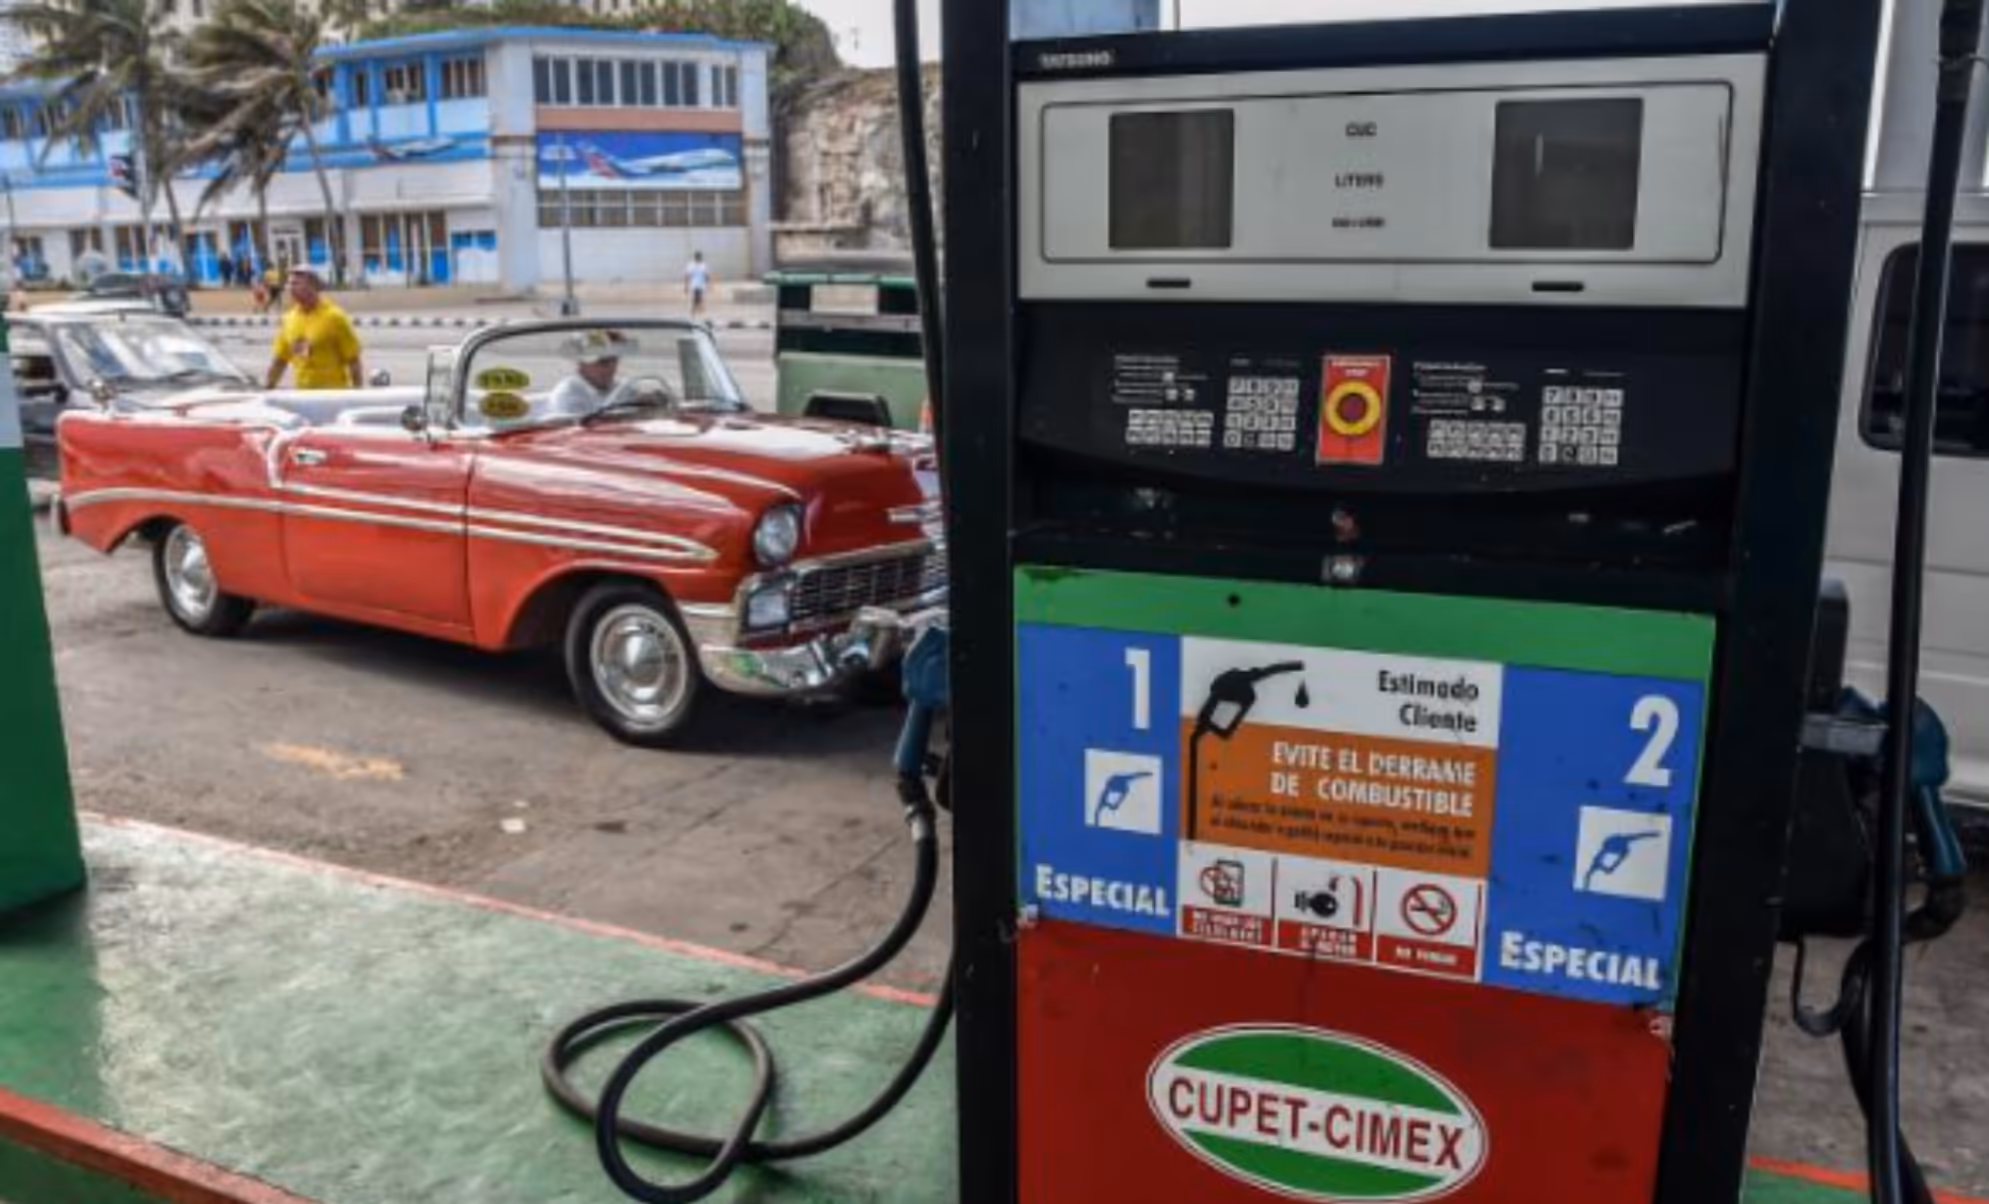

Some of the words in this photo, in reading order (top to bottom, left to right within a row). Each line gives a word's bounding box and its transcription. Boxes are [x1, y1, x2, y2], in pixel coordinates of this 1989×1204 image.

[1124, 647, 1151, 730] 1
[1378, 669, 1479, 700] Estimado
[1398, 702, 1477, 733] Cliente
[1623, 694, 1680, 787] 2
[1273, 741, 1332, 770] EVITE
[1339, 748, 1363, 774] EL
[1369, 750, 1476, 785] DERRAME
[1270, 771, 1299, 797] DE
[1317, 776, 1473, 817] COMBUSTIBLE
[1035, 863, 1170, 916] ESPECIAL
[1500, 930, 1662, 990] ESPECIAL
[1167, 1076, 1464, 1170] CUPET-CIMEX
